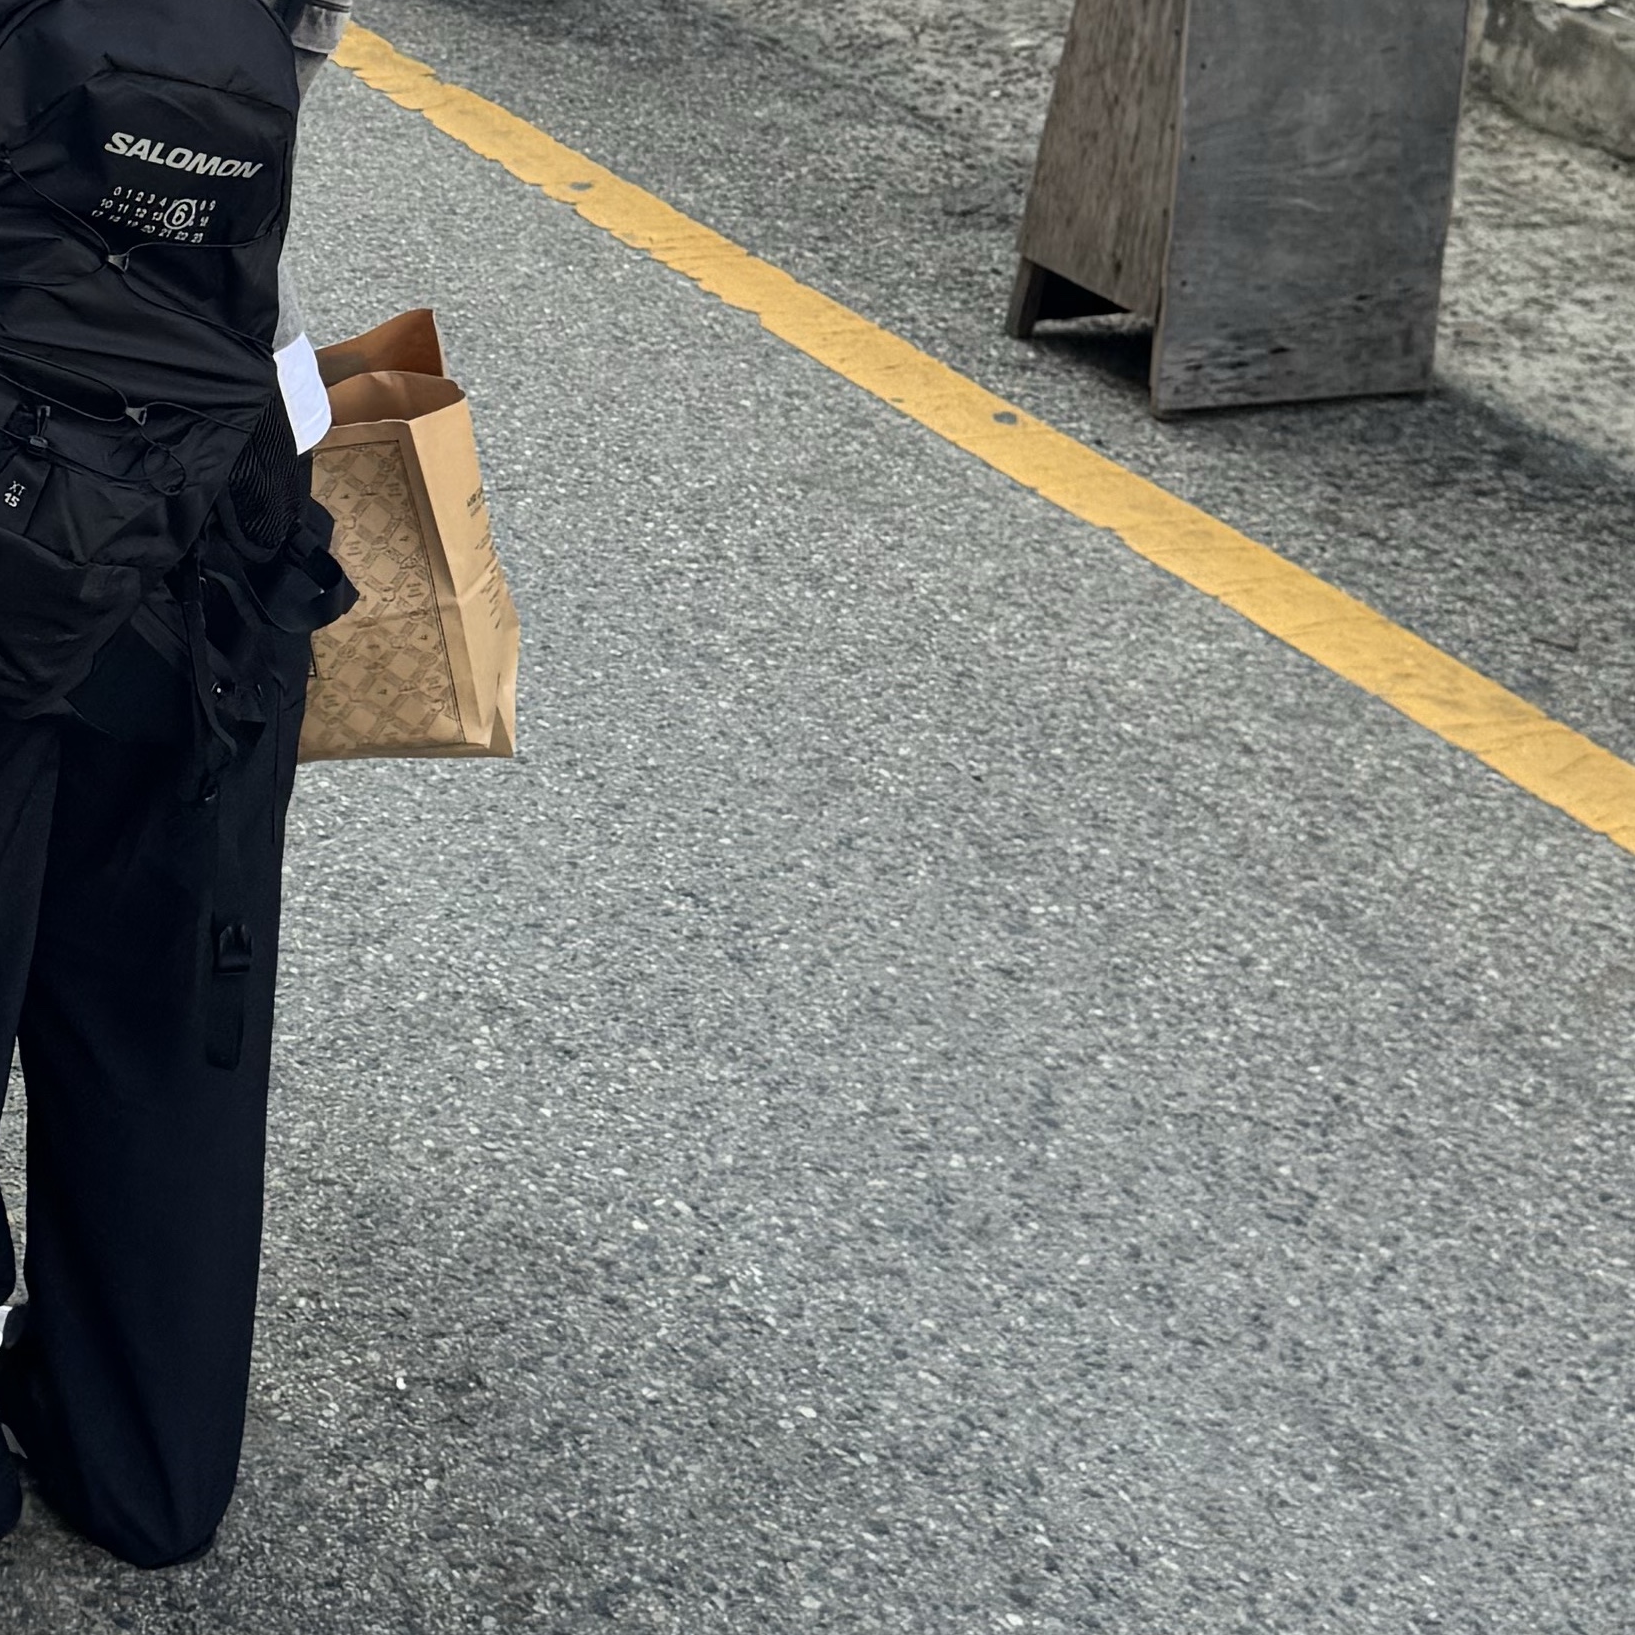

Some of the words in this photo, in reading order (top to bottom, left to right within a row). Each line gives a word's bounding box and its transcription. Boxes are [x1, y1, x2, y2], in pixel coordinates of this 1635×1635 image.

[104, 131, 264, 179] SALOMON
[100, 198, 114, 209] 10
[113, 186, 122, 196] 0
[126, 188, 133, 199] 1
[135, 191, 144, 202] 2
[159, 197, 168, 207] 4
[158, 228, 172, 238] 21
[9, 480, 27, 496] XT
[4, 492, 21, 507] 15
